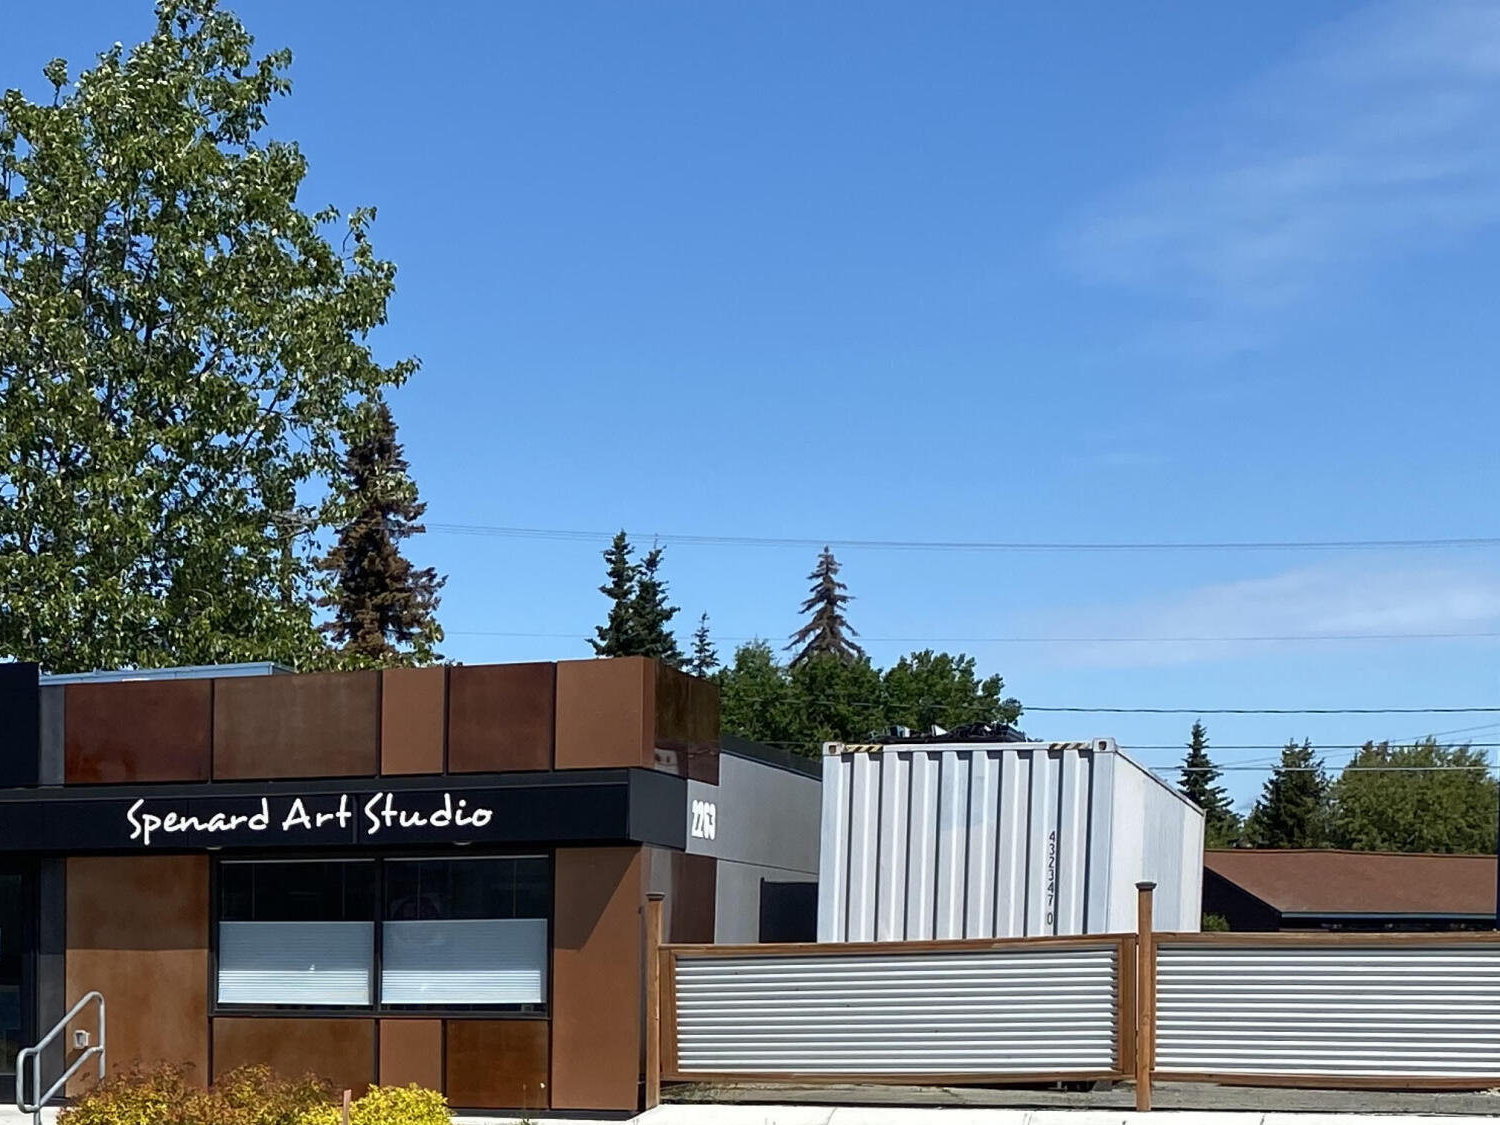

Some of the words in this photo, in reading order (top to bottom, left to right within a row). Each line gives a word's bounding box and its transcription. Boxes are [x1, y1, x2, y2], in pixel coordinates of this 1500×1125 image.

[126, 797, 270, 846] Spenard
[282, 793, 352, 832] Art
[363, 791, 493, 836] Studio
[691, 799, 717, 841] 2263
